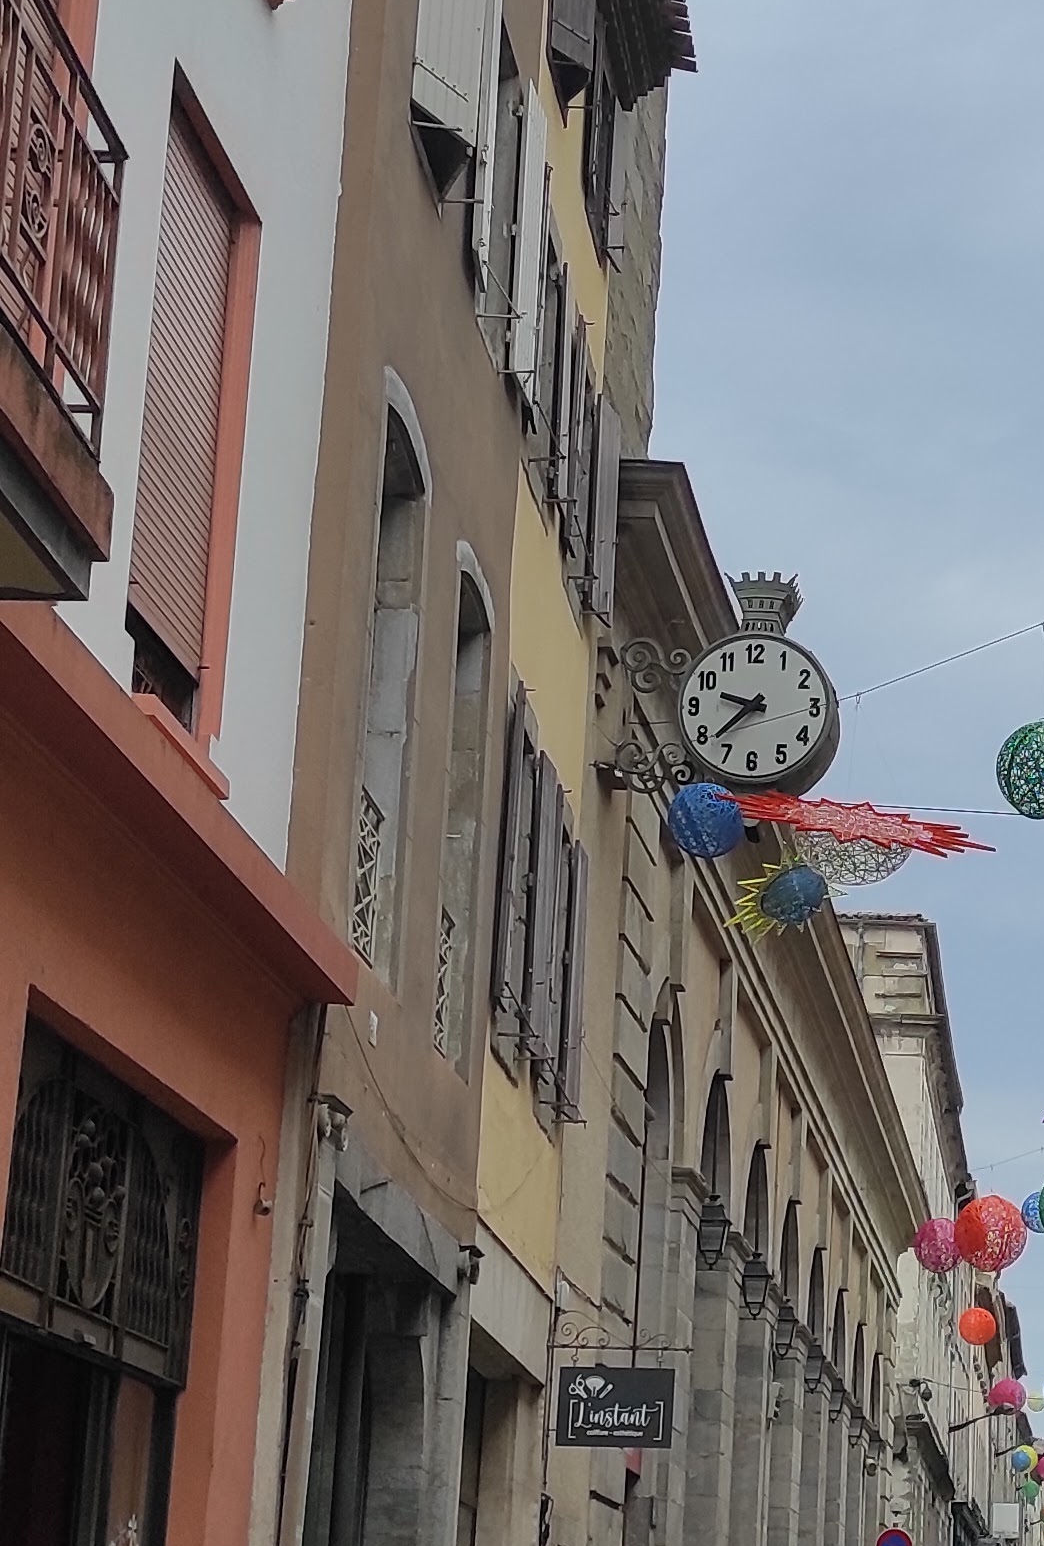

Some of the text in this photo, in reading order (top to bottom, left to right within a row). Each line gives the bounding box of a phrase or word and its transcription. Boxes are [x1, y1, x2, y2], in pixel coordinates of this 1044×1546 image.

[720, 651, 735, 672] 11
[745, 643, 765, 664] 12
[779, 650, 787, 671] 1
[697, 670, 717, 691] 10
[797, 668, 811, 690] 2
[688, 696, 700, 717] 9
[808, 697, 821, 718] 3
[696, 724, 709, 745] 8
[795, 725, 810, 747] 4
[720, 743, 733, 765] 7
[745, 750, 759, 772] 6
[774, 743, 788, 765] 5
